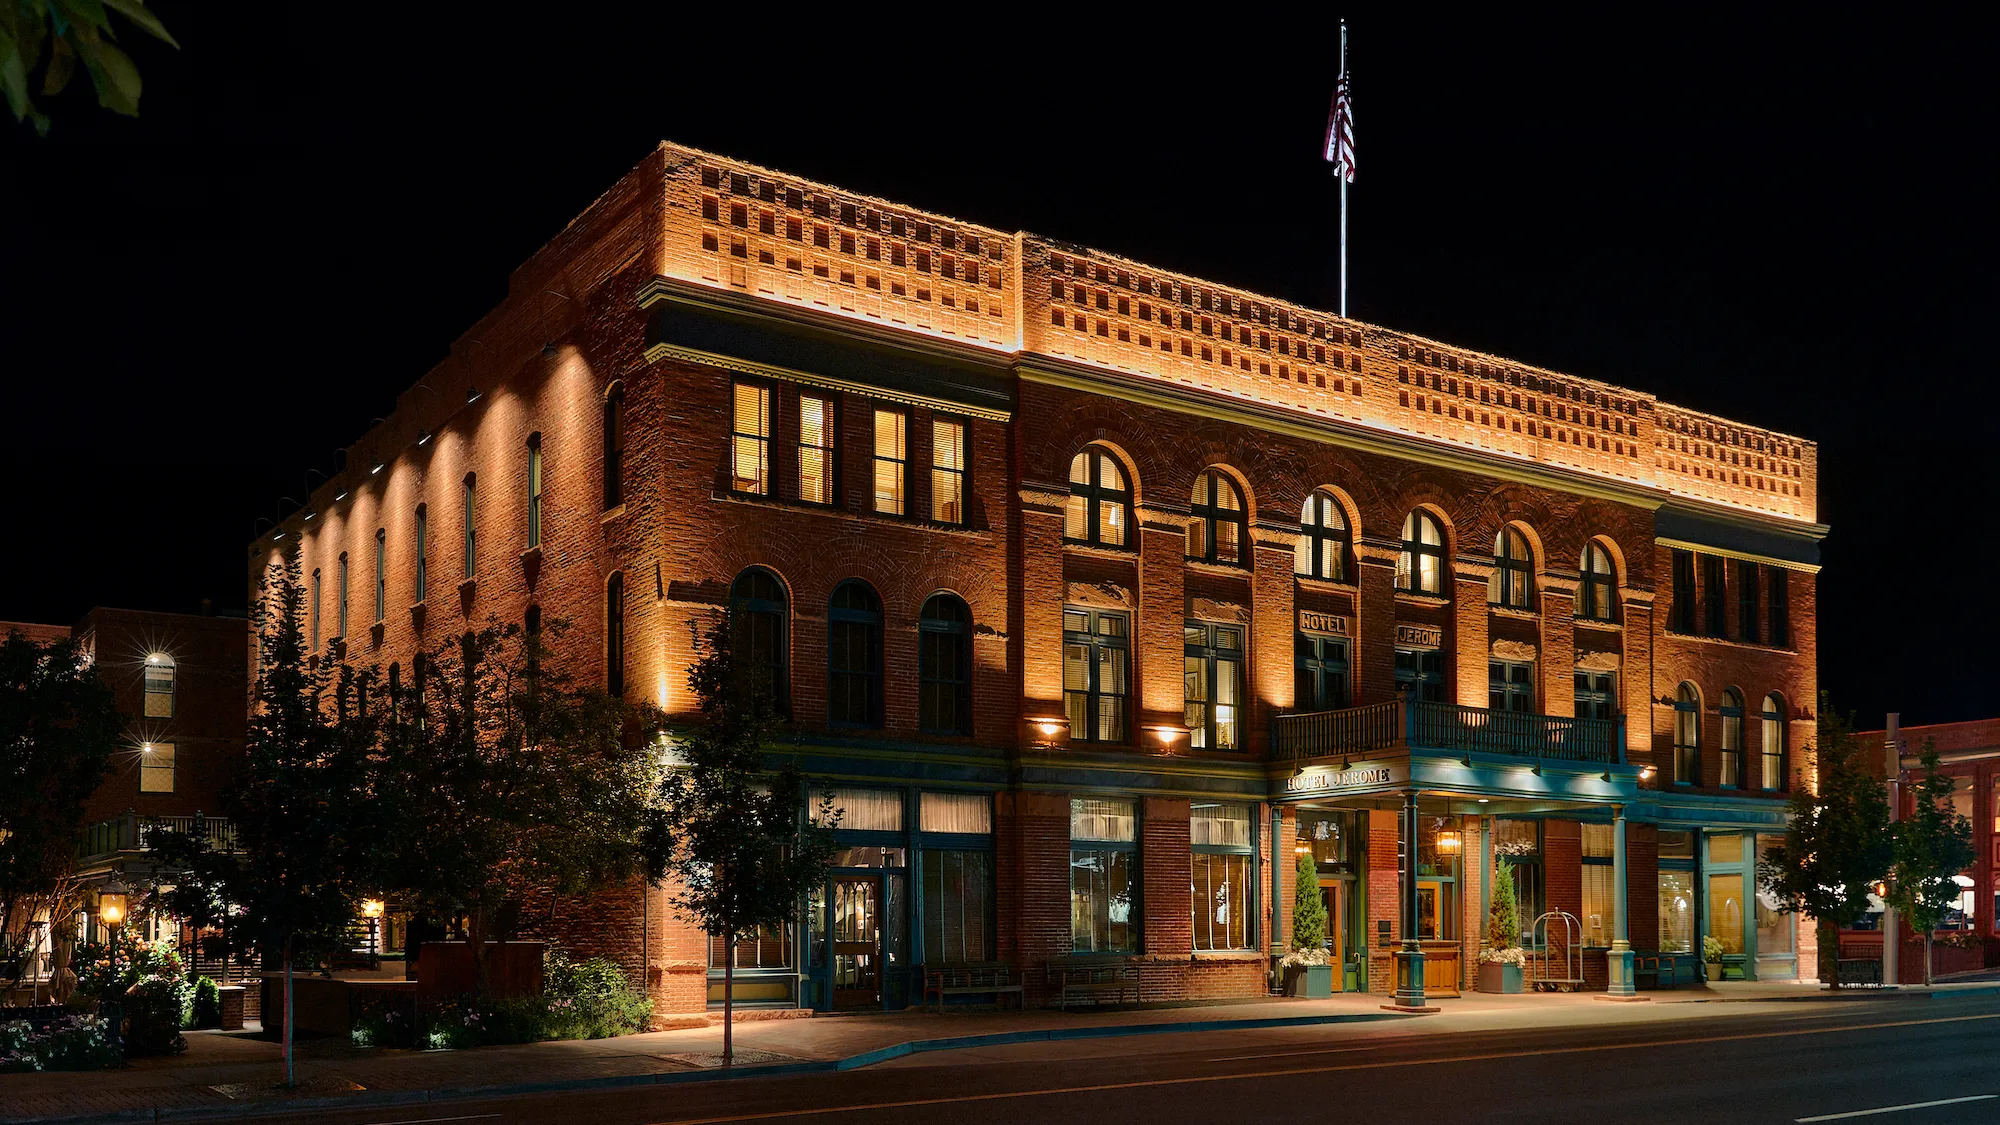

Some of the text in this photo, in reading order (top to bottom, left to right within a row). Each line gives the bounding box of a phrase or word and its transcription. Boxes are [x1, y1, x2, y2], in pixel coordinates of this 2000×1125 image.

[1302, 613, 1345, 633] HOTEL
[1287, 769, 1389, 791] HOTEL JEROME
